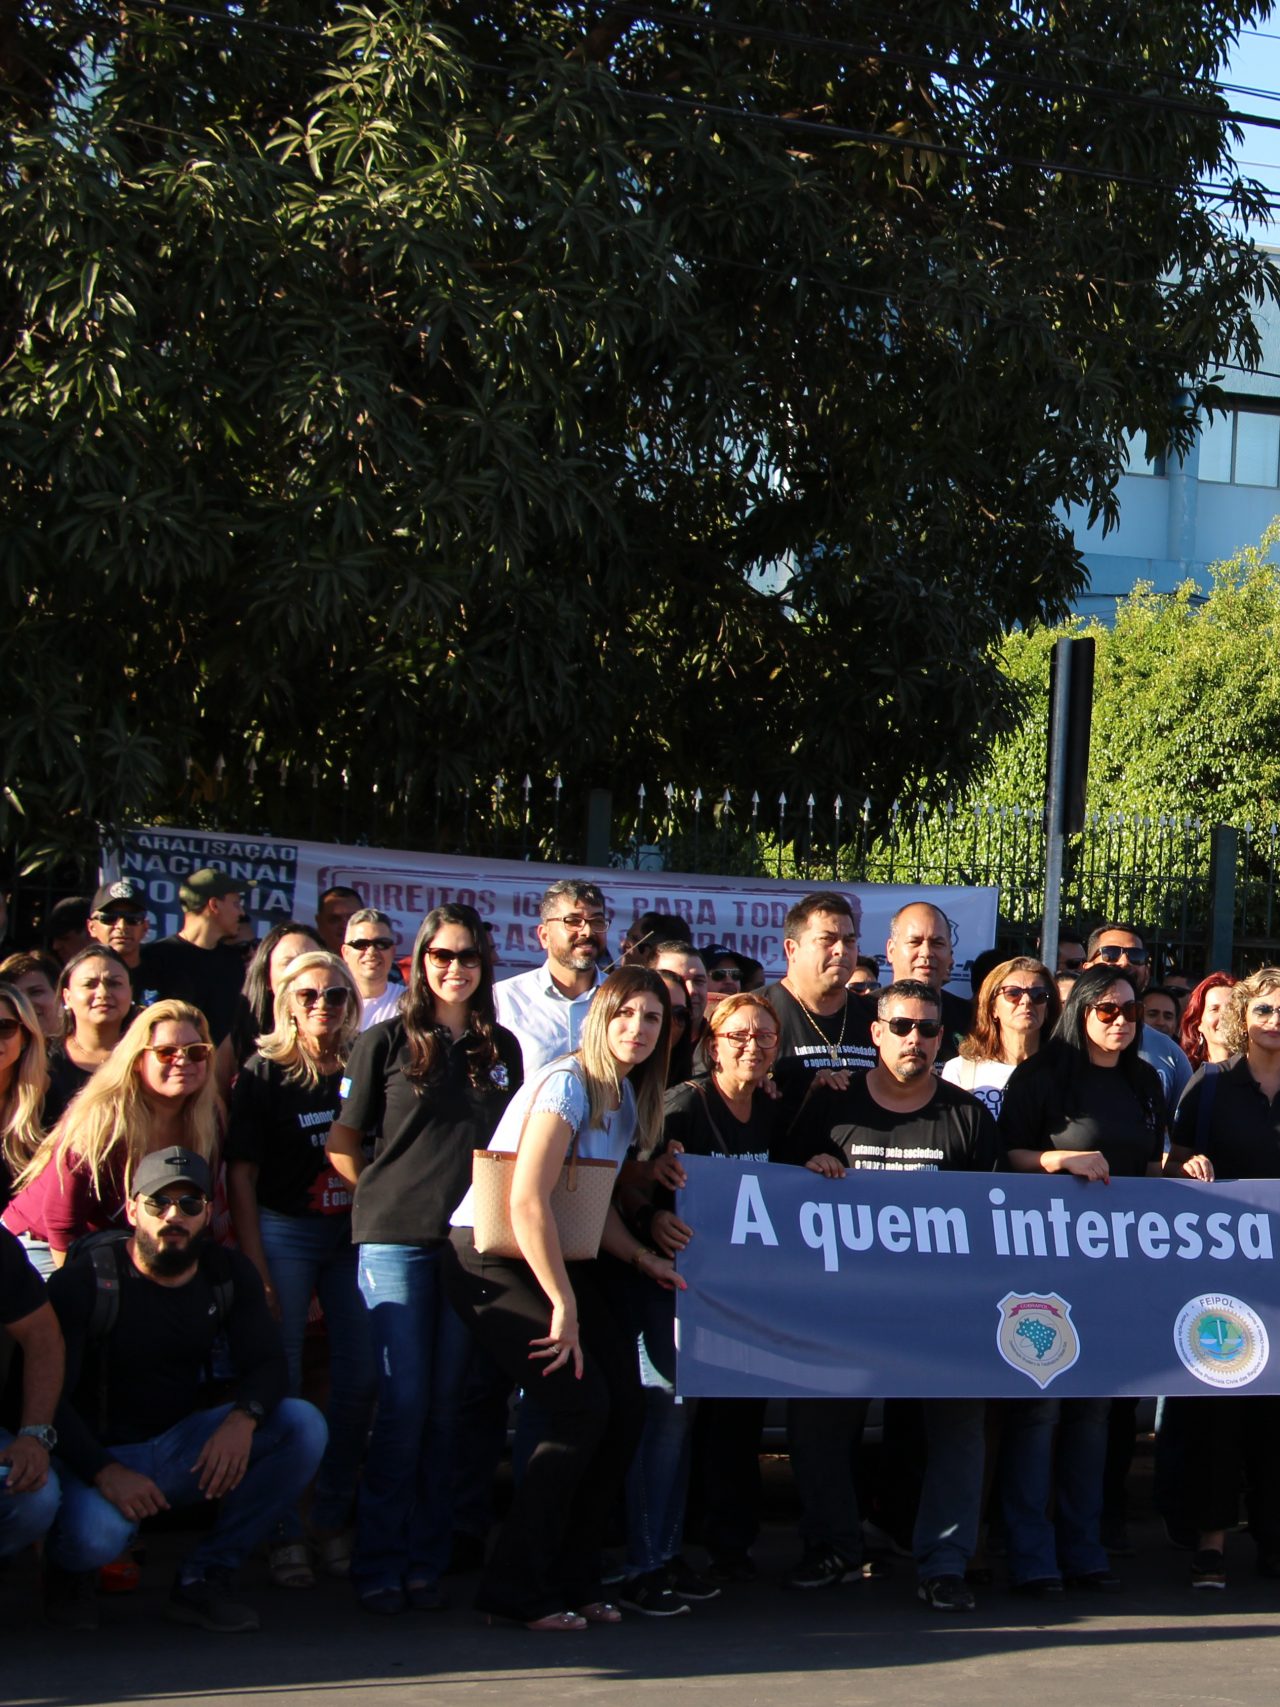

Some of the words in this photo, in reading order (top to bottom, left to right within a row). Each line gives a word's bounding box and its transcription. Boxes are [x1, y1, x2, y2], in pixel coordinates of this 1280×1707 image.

[632, 897, 717, 926] PARA
[794, 1045, 827, 1056] Lutamos
[842, 1044, 877, 1056] sociedade
[804, 1059, 810, 1067] e
[810, 1058, 831, 1068] agora
[851, 1144, 884, 1156] Lutamos
[885, 1147, 903, 1158] pela
[903, 1147, 944, 1160] sociedade
[731, 1175, 778, 1246] A
[800, 1202, 969, 1272] quem
[989, 1189, 1273, 1260] interessa
[1199, 1297, 1234, 1309] FEIPOL
